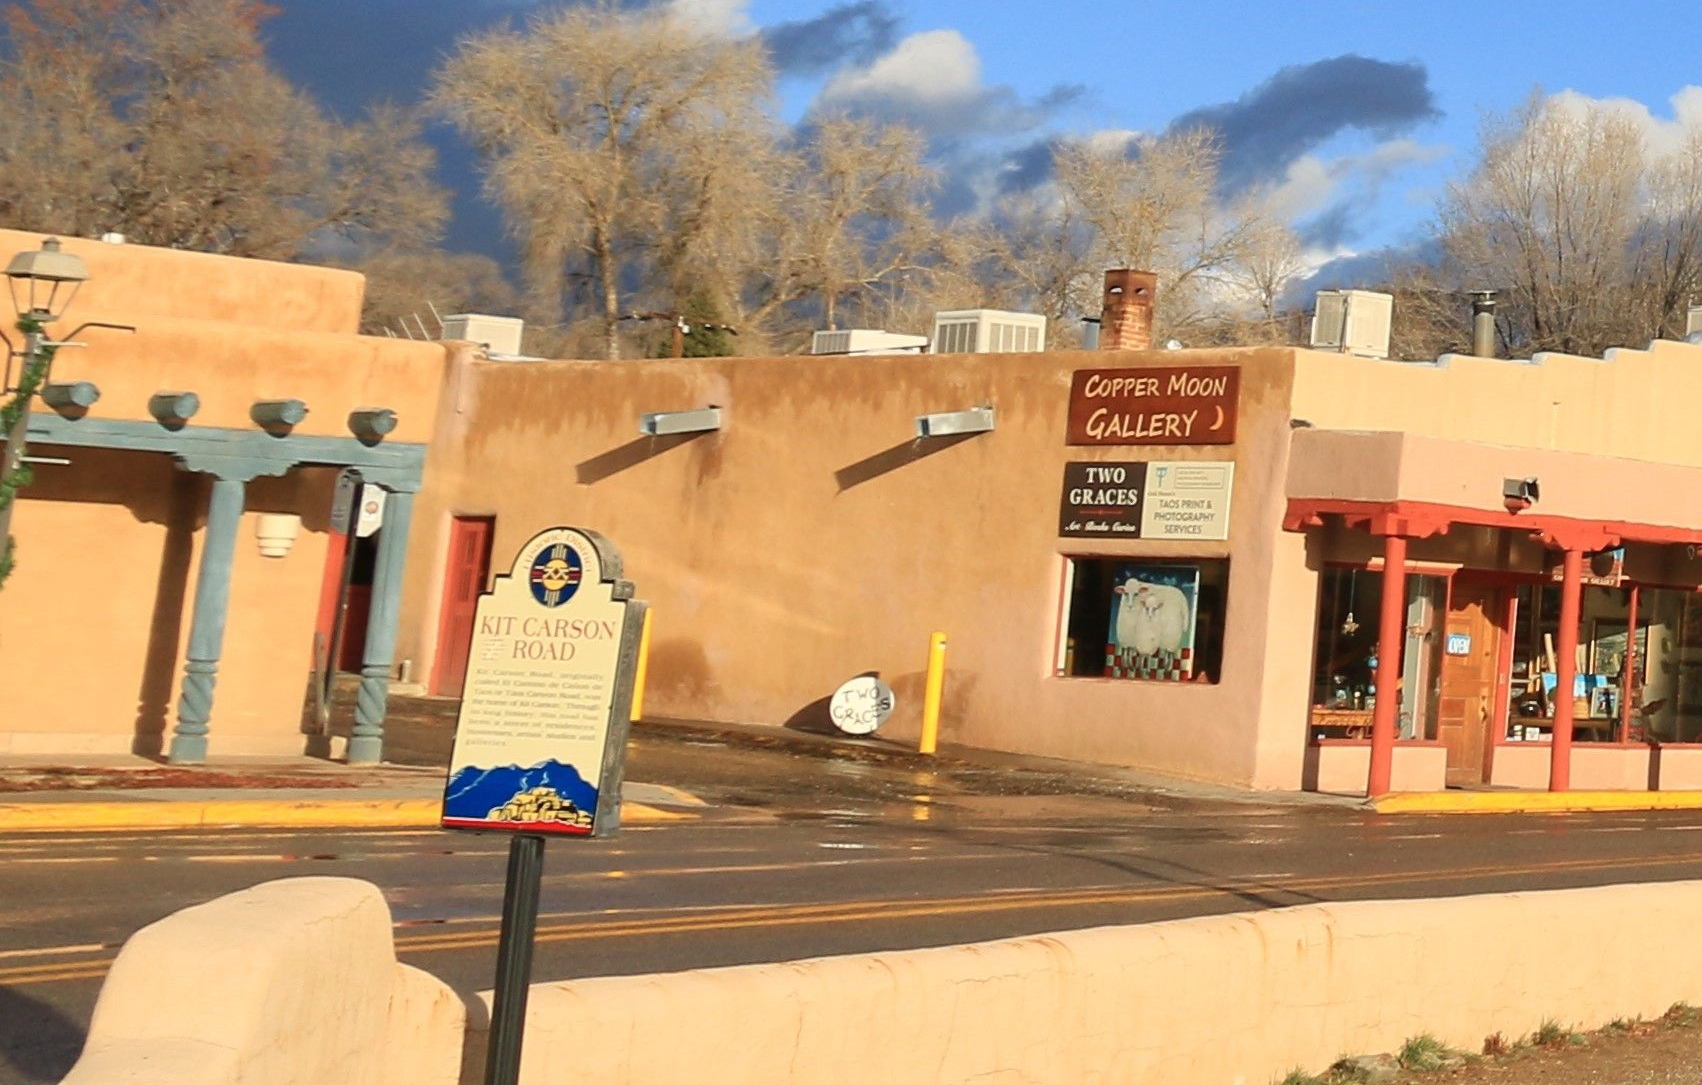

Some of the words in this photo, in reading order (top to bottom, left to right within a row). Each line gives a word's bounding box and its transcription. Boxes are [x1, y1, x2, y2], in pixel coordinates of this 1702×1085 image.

[1084, 374, 1160, 398] COPPER
[1167, 372, 1227, 397] MOON
[1085, 407, 1198, 440] GALLERY
[1086, 467, 1126, 484] TWO
[1069, 488, 1138, 506] GRACES
[1159, 499, 1179, 509] TAOS
[1181, 499, 1205, 509] PRINT
[1153, 512, 1215, 521] PHOTOGRAPHY
[1164, 525, 1202, 534] SERVICES
[480, 615, 518, 636] KIT
[522, 617, 616, 640] CARSON
[512, 640, 576, 661] ROAD
[842, 686, 880, 703] TWO
